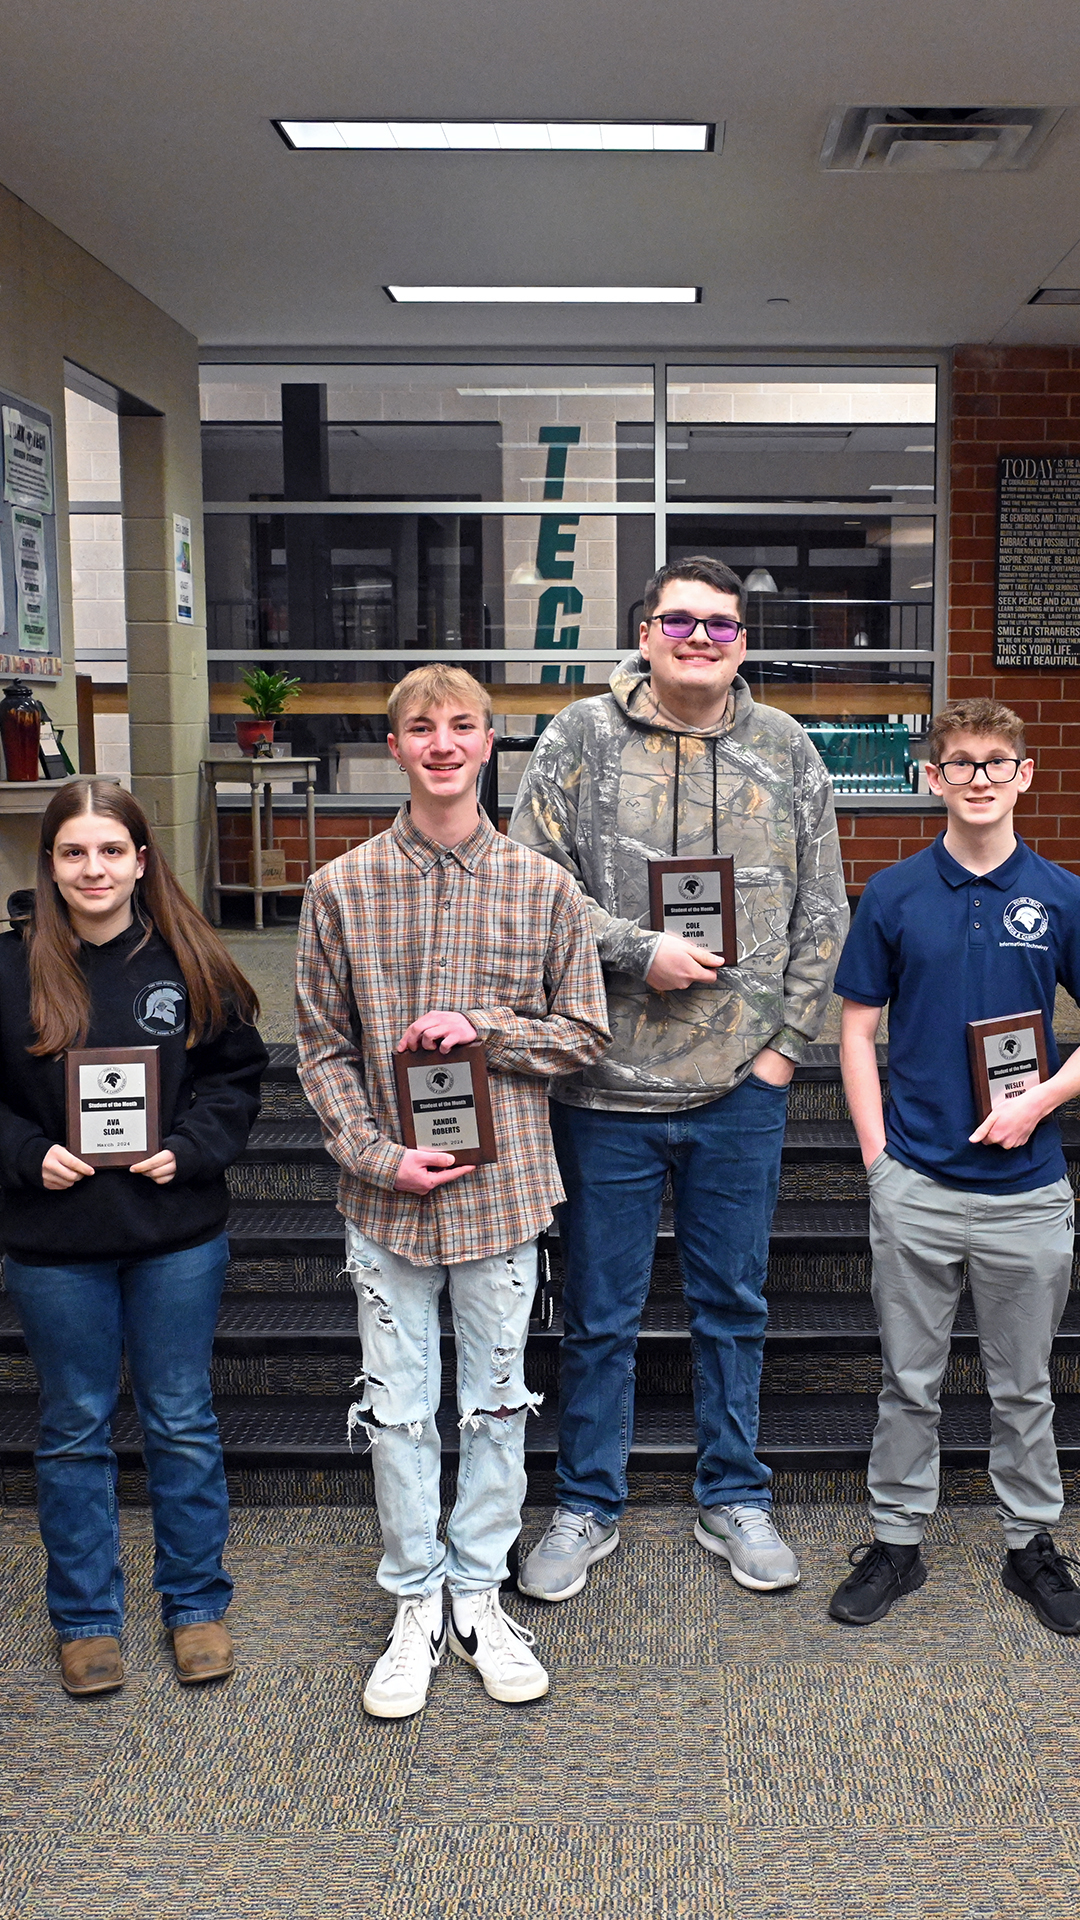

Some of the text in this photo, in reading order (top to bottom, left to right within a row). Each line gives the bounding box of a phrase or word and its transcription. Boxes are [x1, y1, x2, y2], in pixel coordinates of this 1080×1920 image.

[1002, 459, 1056, 478] TODAY
[1001, 514, 1080, 522] BE GENEROUS AND TRUTHFU
[1000, 538, 1080, 546] EMBRACE NEW POSSIBILITIE
[999, 556, 1022, 564] INSPIRE
[1055, 556, 1062, 564] BE
[1064, 556, 1080, 564] BRAV
[998, 597, 1017, 605] SEEK
[1019, 597, 1042, 605] PEACE
[1044, 597, 1059, 605] AND
[998, 627, 1080, 636] SMILE AT STRANGERS
[998, 645, 1080, 655] THIS IS YOUR LIFE...
[997, 656, 1021, 665] MAKE
[1024, 656, 1032, 665] IT
[1026, 942, 1049, 951] Technology
[1005, 1081, 1024, 1090] WESLEY
[433, 1117, 457, 1126] XANDER
[432, 1126, 460, 1136] ROBERTS
